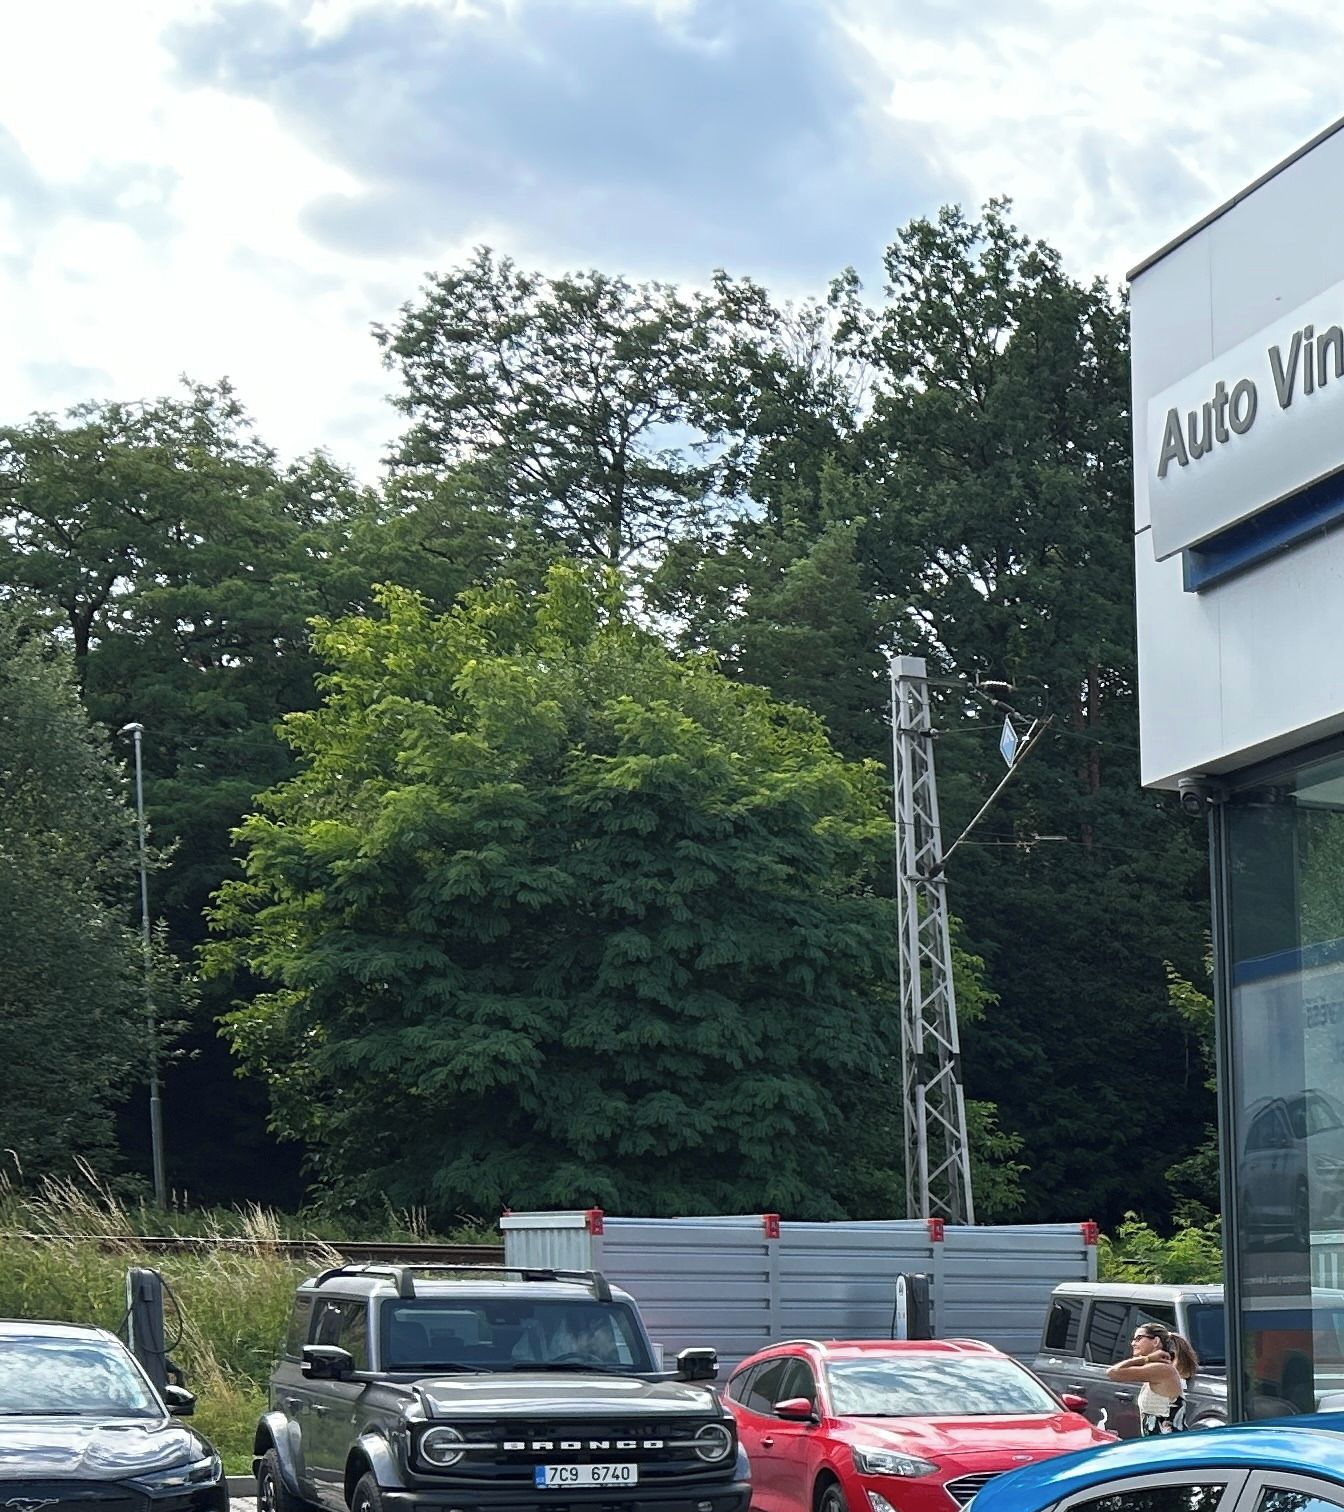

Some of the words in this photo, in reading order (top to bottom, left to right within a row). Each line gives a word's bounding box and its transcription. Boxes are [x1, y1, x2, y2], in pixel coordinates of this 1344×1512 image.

[1156, 379, 1258, 480] Auto
[503, 1440, 664, 1450] BRONCO
[549, 1466, 579, 1482] 7C9
[591, 1465, 630, 1481] 6740
